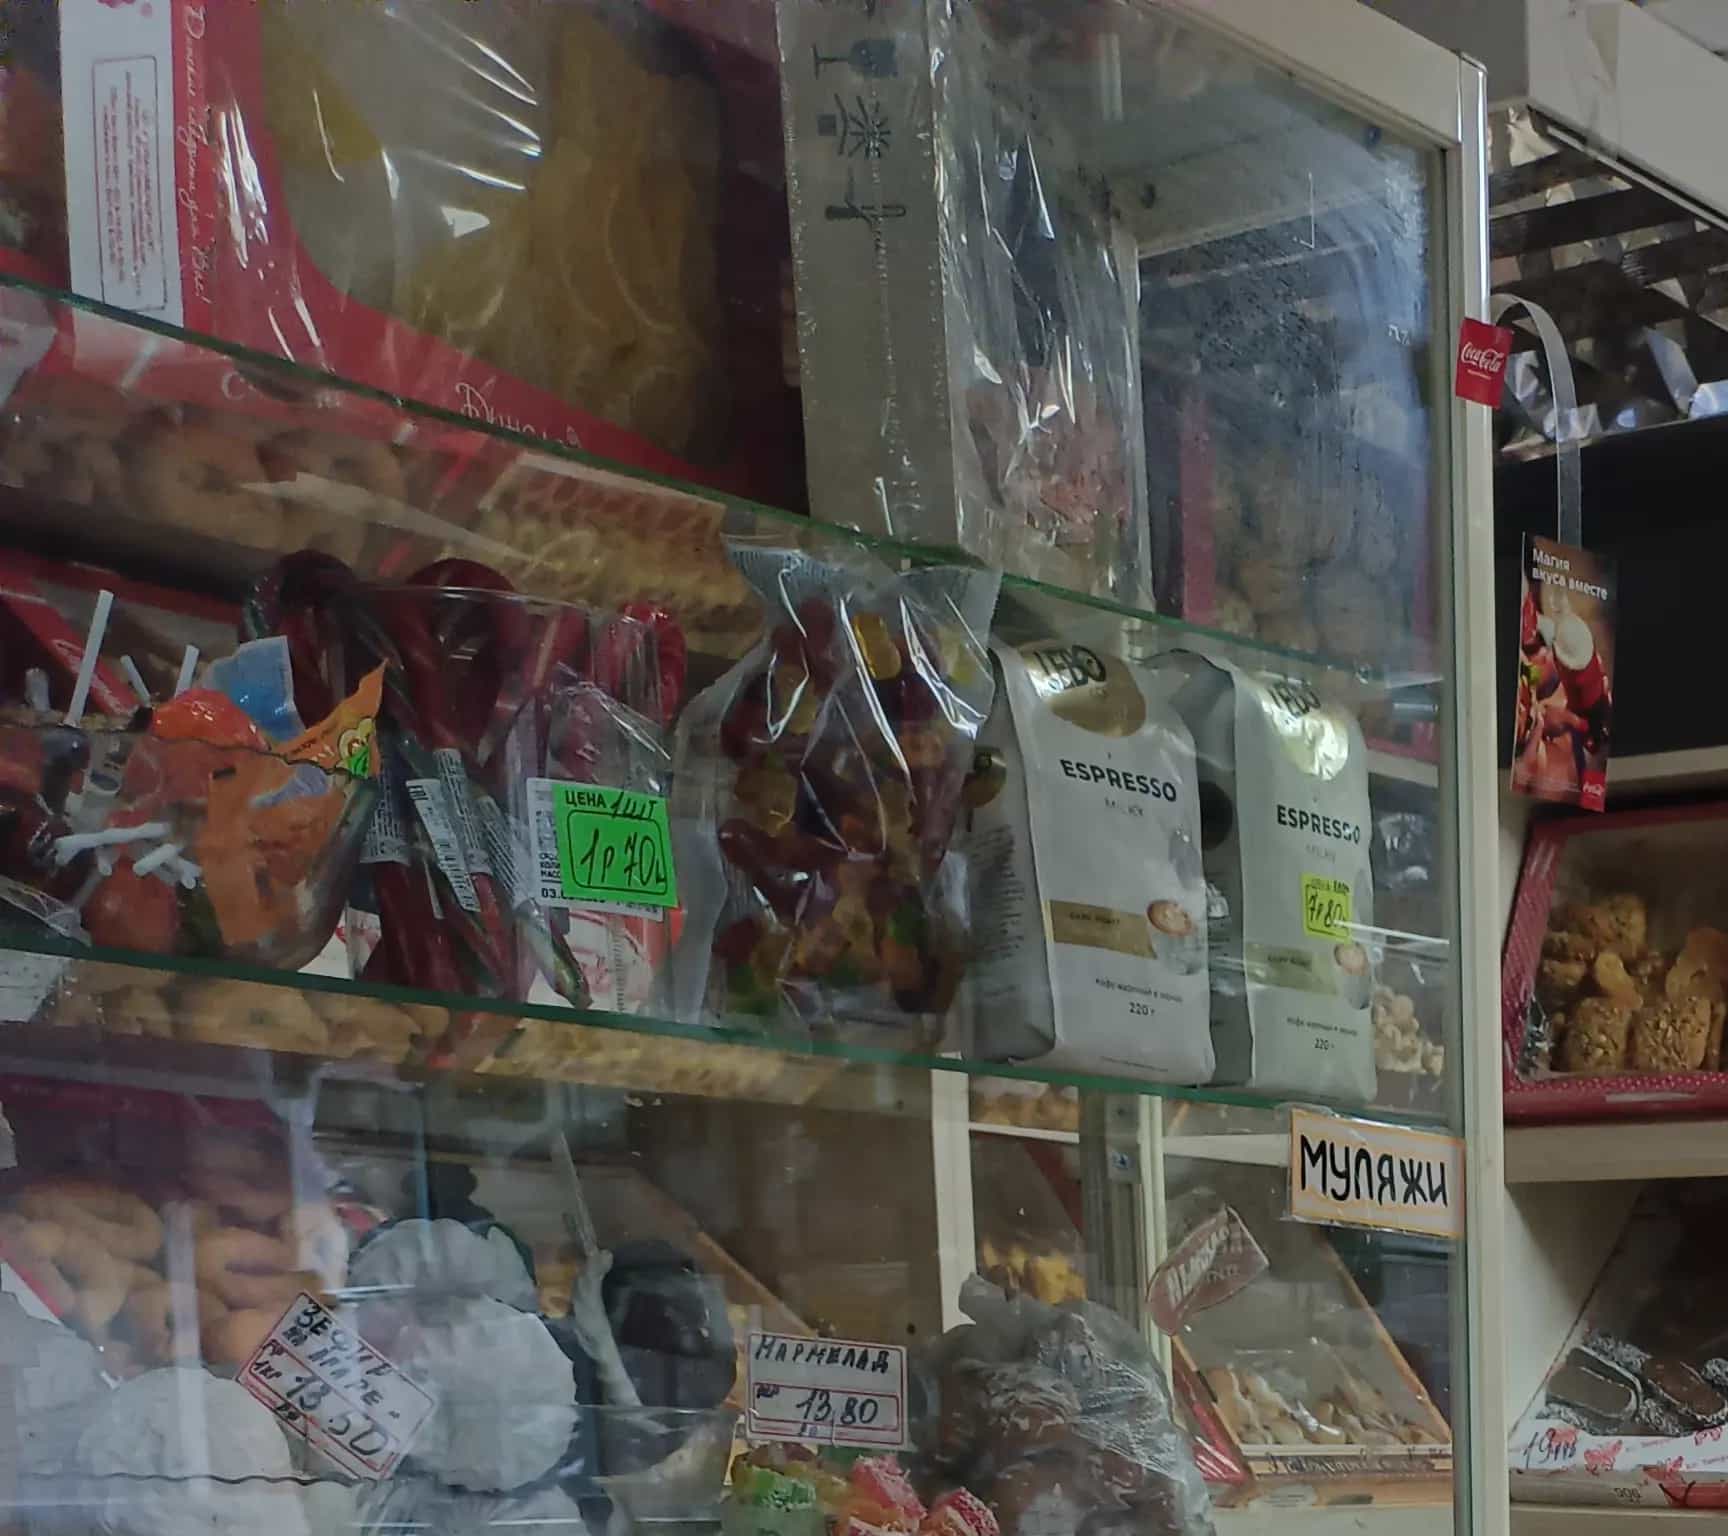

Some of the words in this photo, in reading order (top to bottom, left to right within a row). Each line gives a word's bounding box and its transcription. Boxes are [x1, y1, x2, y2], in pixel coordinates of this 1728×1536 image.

[1533, 548, 1570, 571] Магия
[565, 790, 607, 809] ЦЕНА
[1060, 759, 1177, 802] ESPRESSO
[1277, 804, 1361, 845] ESPRESSO
[1129, 1001, 1149, 1016] 220
[1301, 1135, 1449, 1207] МУЛЯЖИ
[755, 1334, 889, 1374] МАРМЕЛАД
